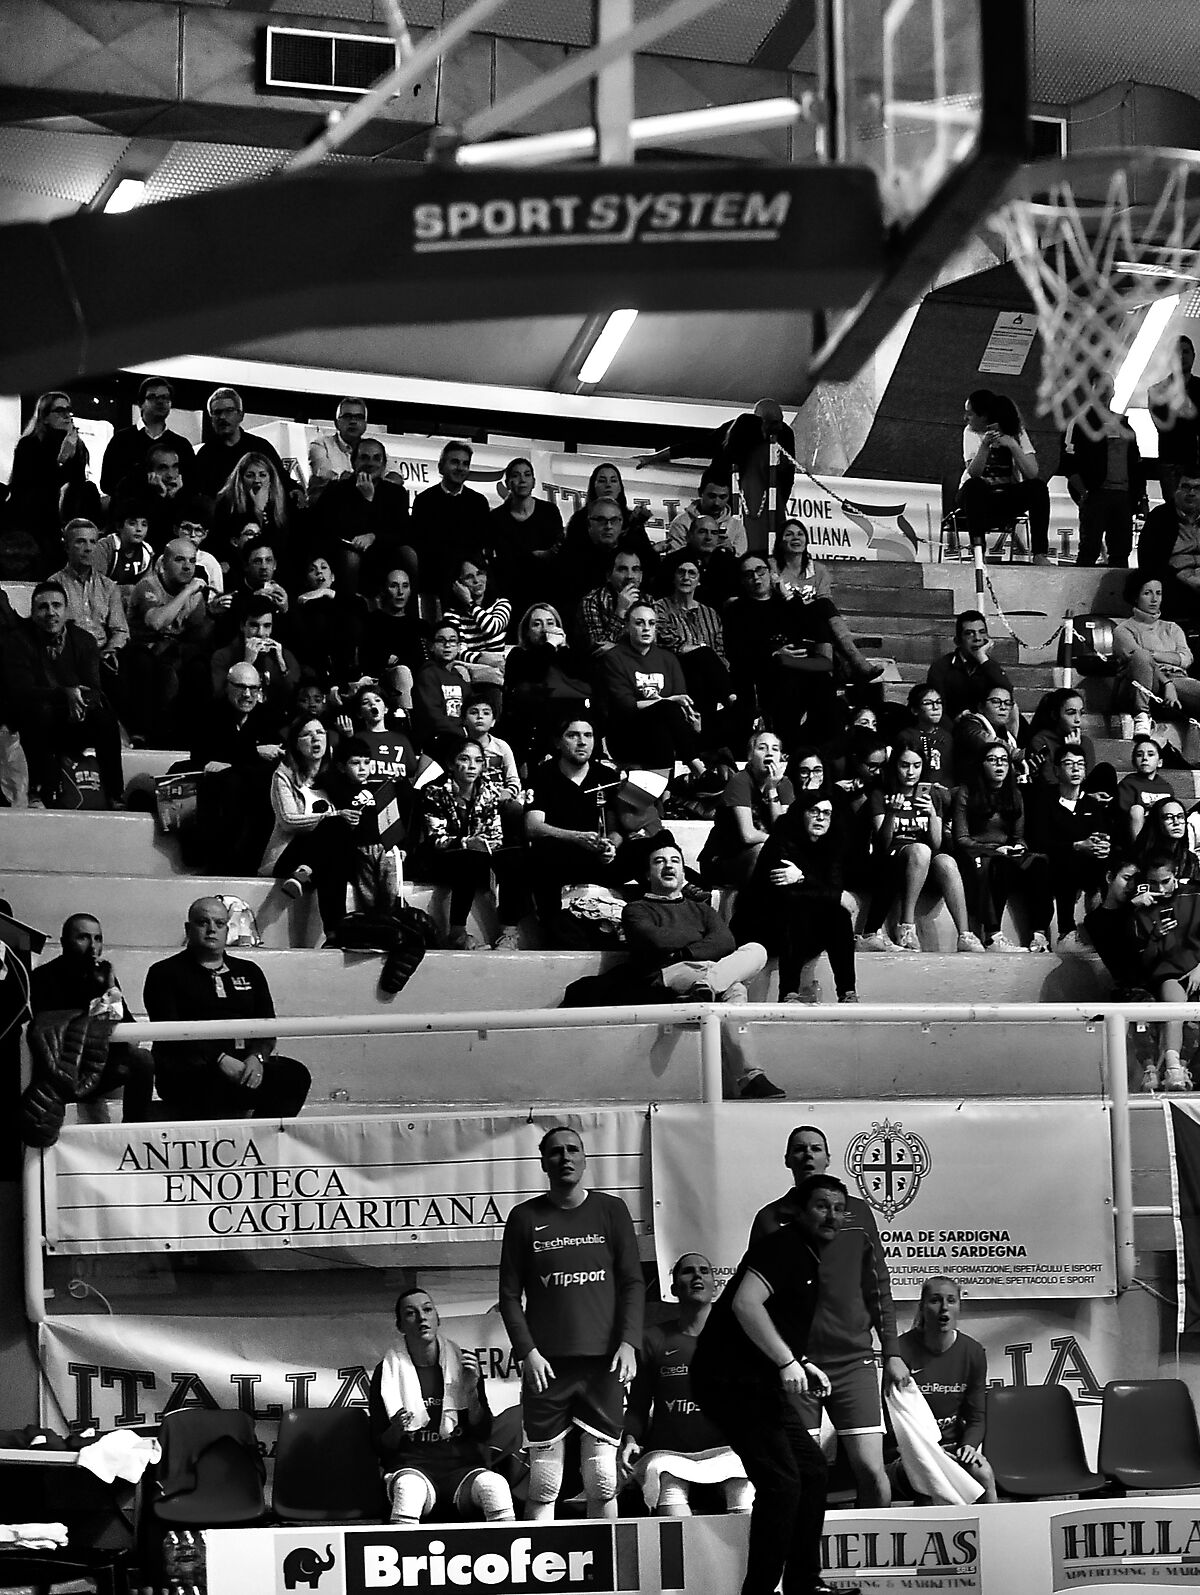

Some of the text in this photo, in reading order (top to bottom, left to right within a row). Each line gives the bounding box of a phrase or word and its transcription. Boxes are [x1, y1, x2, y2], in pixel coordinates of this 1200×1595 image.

[413, 191, 792, 243] SPORT SYSTEM
[117, 1138, 266, 1172] ANTICA
[165, 1169, 349, 1203] ENOTECA
[208, 1196, 507, 1235] CAGLIARITANA
[879, 1230, 1011, 1243] OMA DE SARDIGNA
[906, 1246, 947, 1258] DELLA
[950, 1245, 1028, 1258] SARDEGNA
[1064, 1264, 1071, 1272] E
[1072, 1264, 1103, 1272] ISPORT
[552, 1269, 606, 1287] Tipsport
[1006, 1276, 1058, 1284] SPETTACOLO
[363, 1539, 593, 1588] Bricofer
[1064, 1567, 1146, 1580] ADVERTISING
[900, 1578, 976, 1589] MARKETING
